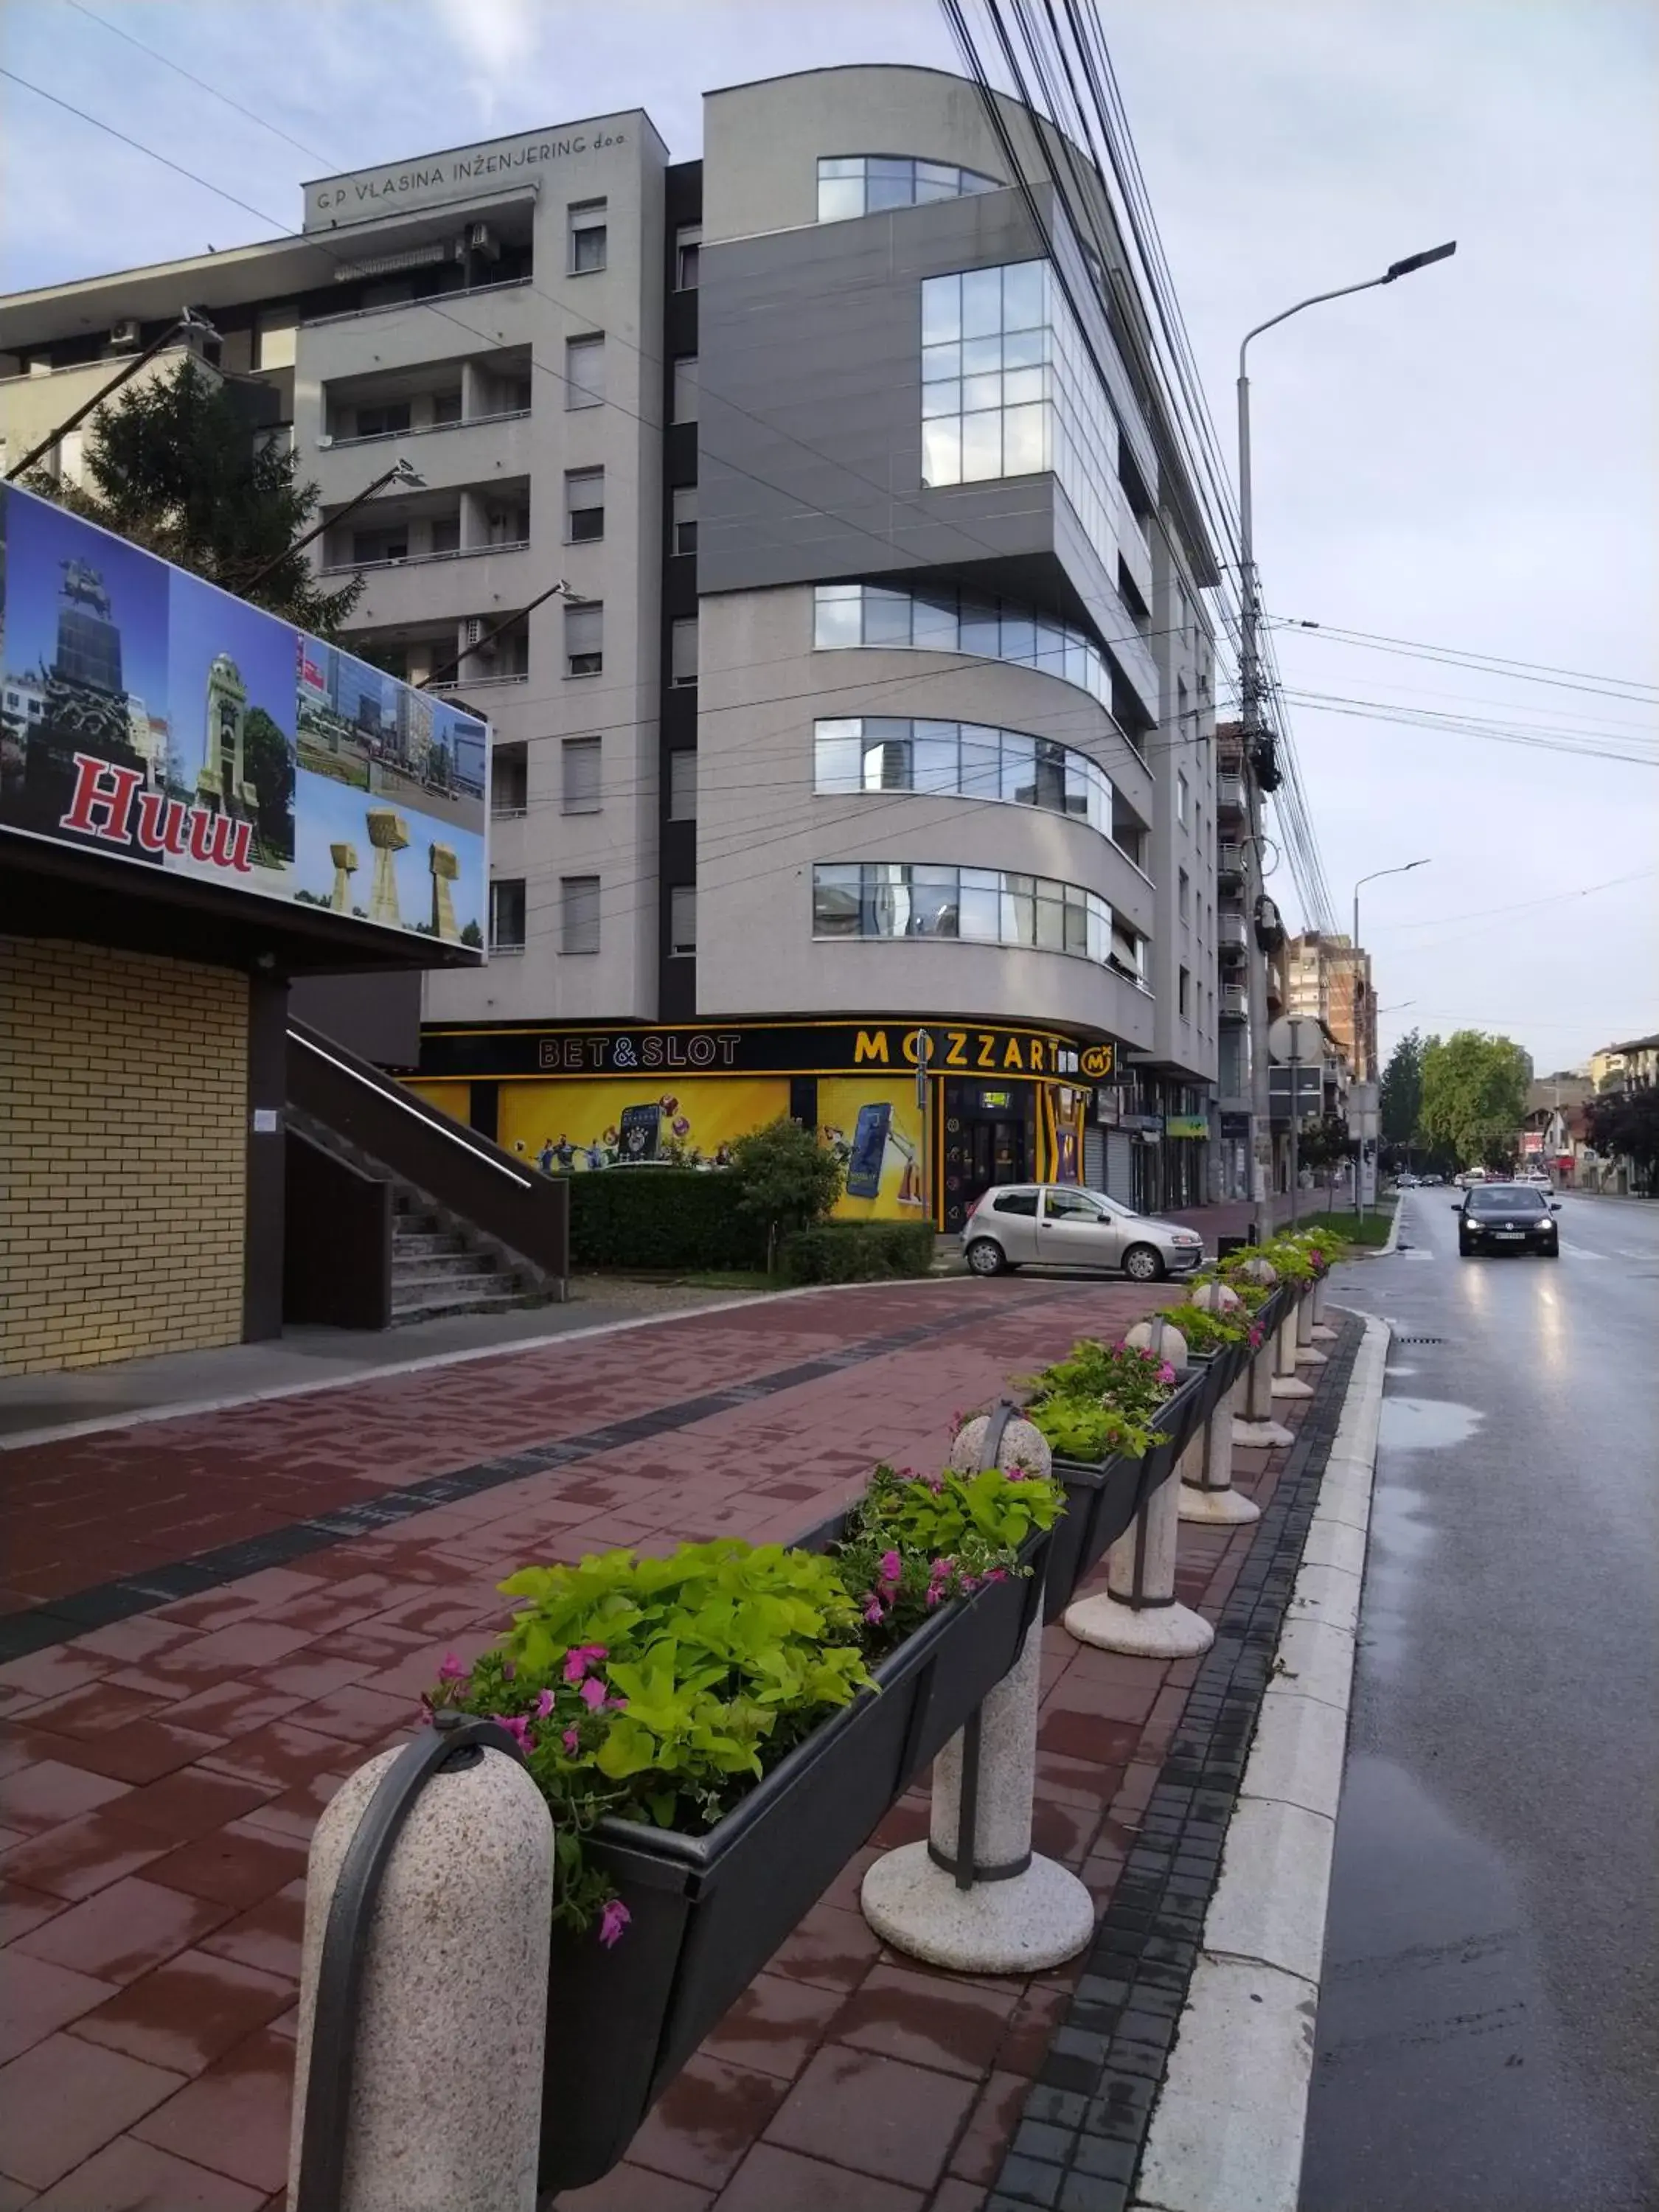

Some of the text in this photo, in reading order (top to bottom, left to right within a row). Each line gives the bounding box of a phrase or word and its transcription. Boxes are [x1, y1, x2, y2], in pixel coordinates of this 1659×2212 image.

[355, 167, 445, 201] VLASINA
[452, 136, 587, 181] INŽENJERING
[59, 751, 252, 873] Ниш
[854, 1030, 1060, 1072] MOZZART
